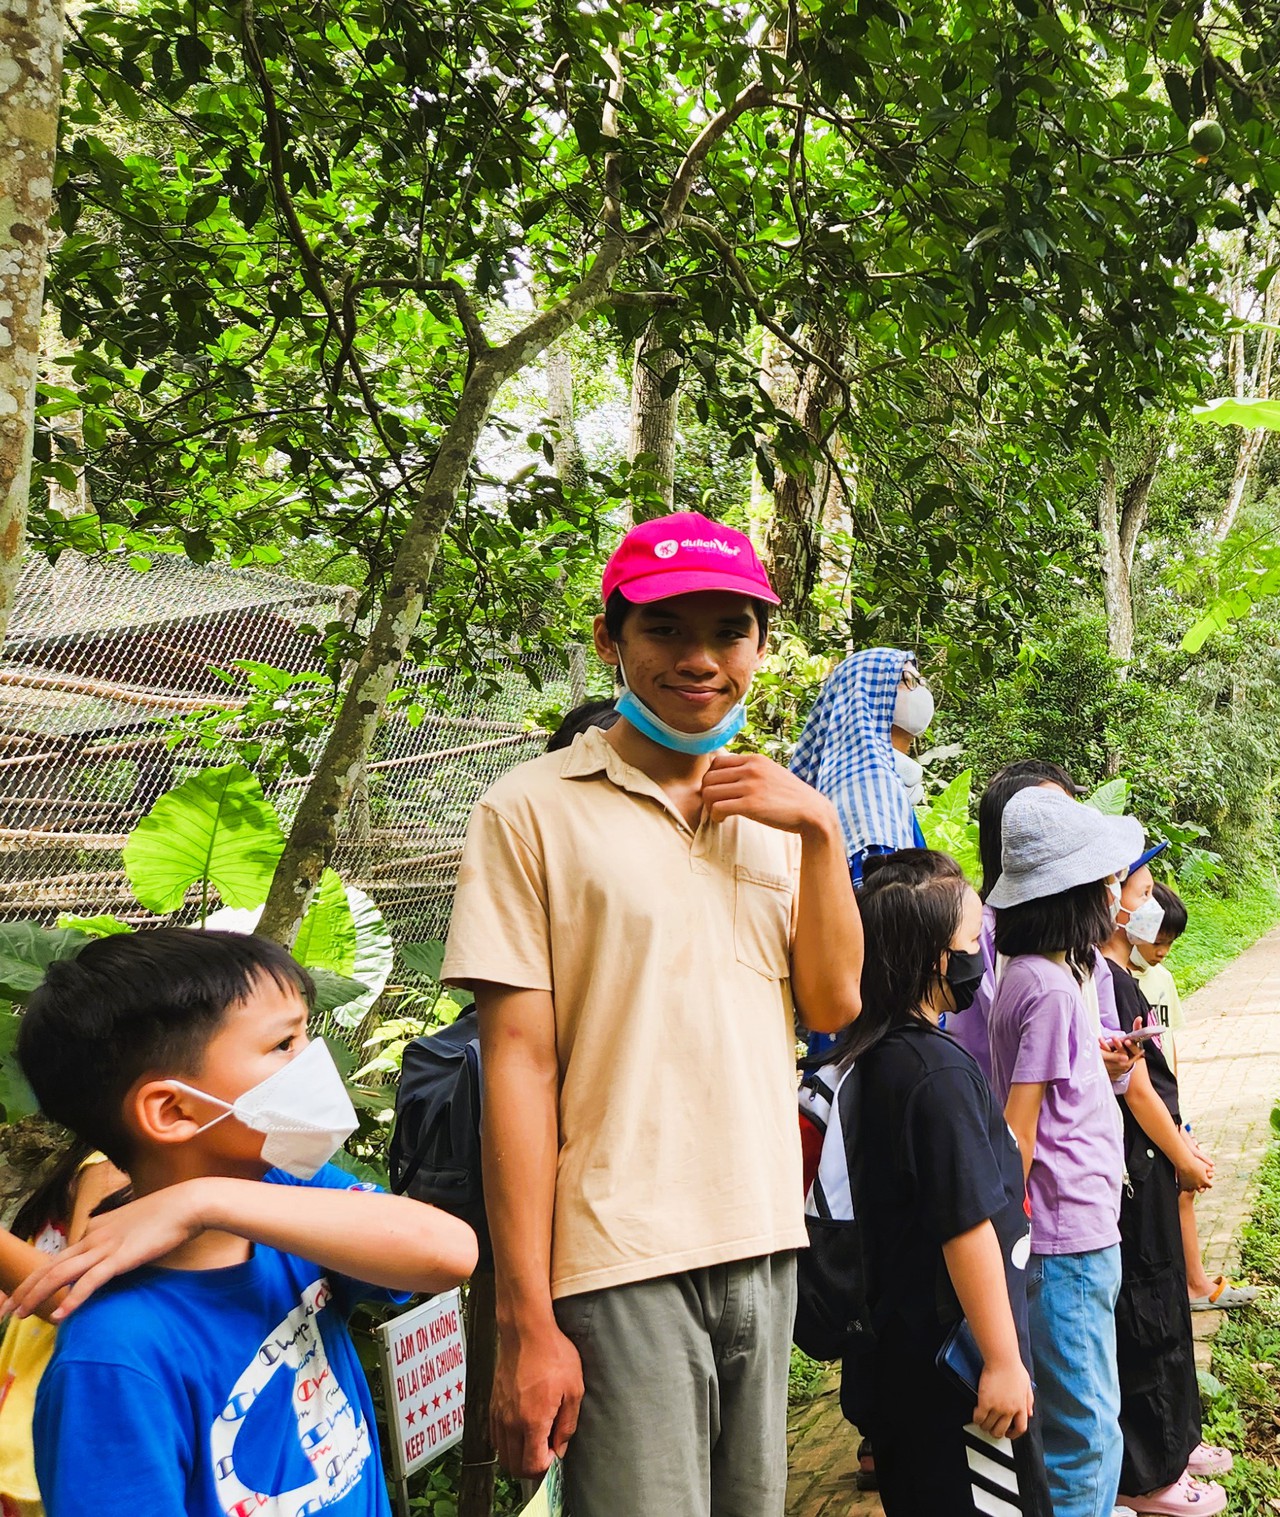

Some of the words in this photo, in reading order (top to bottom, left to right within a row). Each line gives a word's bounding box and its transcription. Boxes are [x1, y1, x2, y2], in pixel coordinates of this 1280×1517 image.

[394, 1332, 415, 1366] LÀM
[416, 1326, 429, 1353] ƠN
[429, 1310, 458, 1345] KHÔNG
[396, 1375, 407, 1402] ĐI
[407, 1367, 420, 1398] LẠI
[405, 1430, 425, 1463] KEEP
[427, 1423, 437, 1449] TO
[437, 1412, 452, 1441] THE
